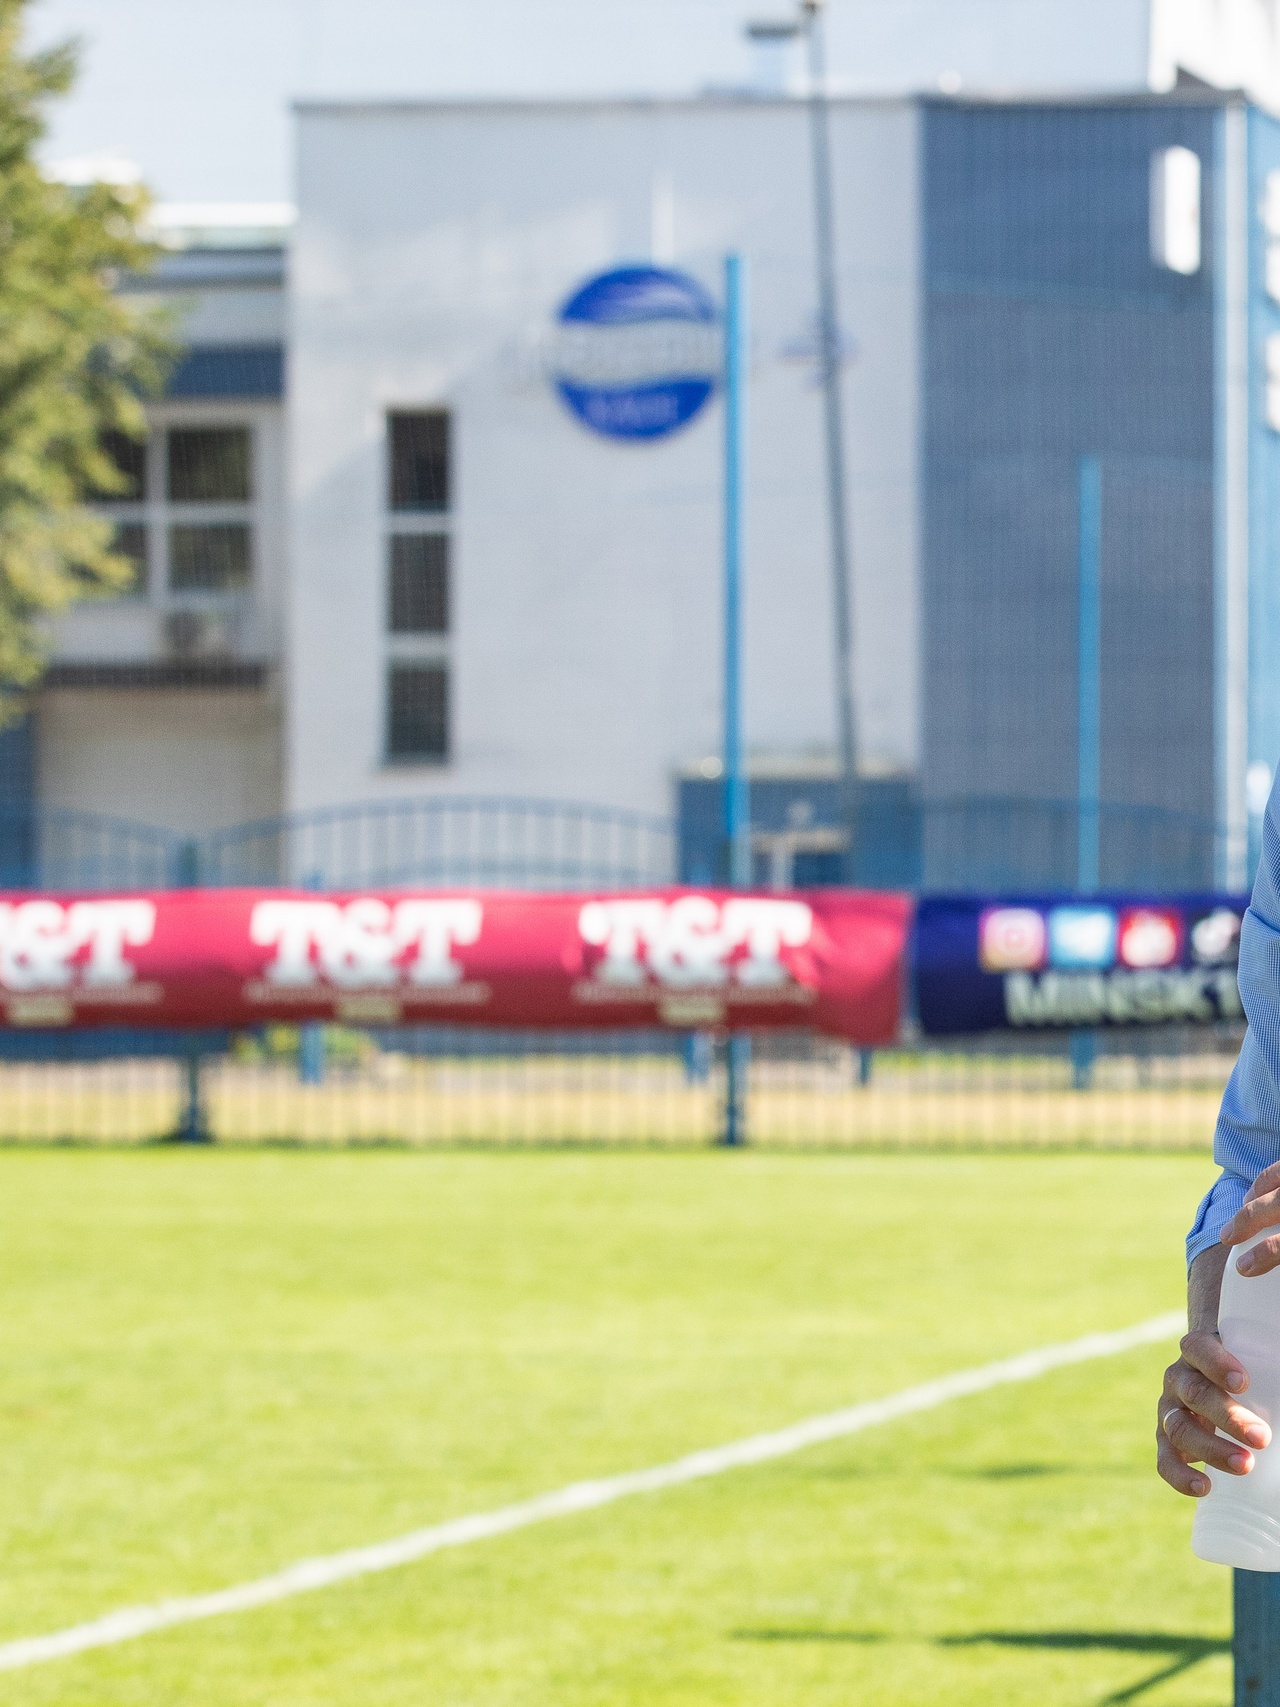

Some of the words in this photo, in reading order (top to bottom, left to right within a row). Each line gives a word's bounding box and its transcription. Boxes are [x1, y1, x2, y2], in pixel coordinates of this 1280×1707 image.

[0, 898, 157, 989] &T
[248, 898, 484, 988] T&T
[577, 895, 813, 991] T&T
